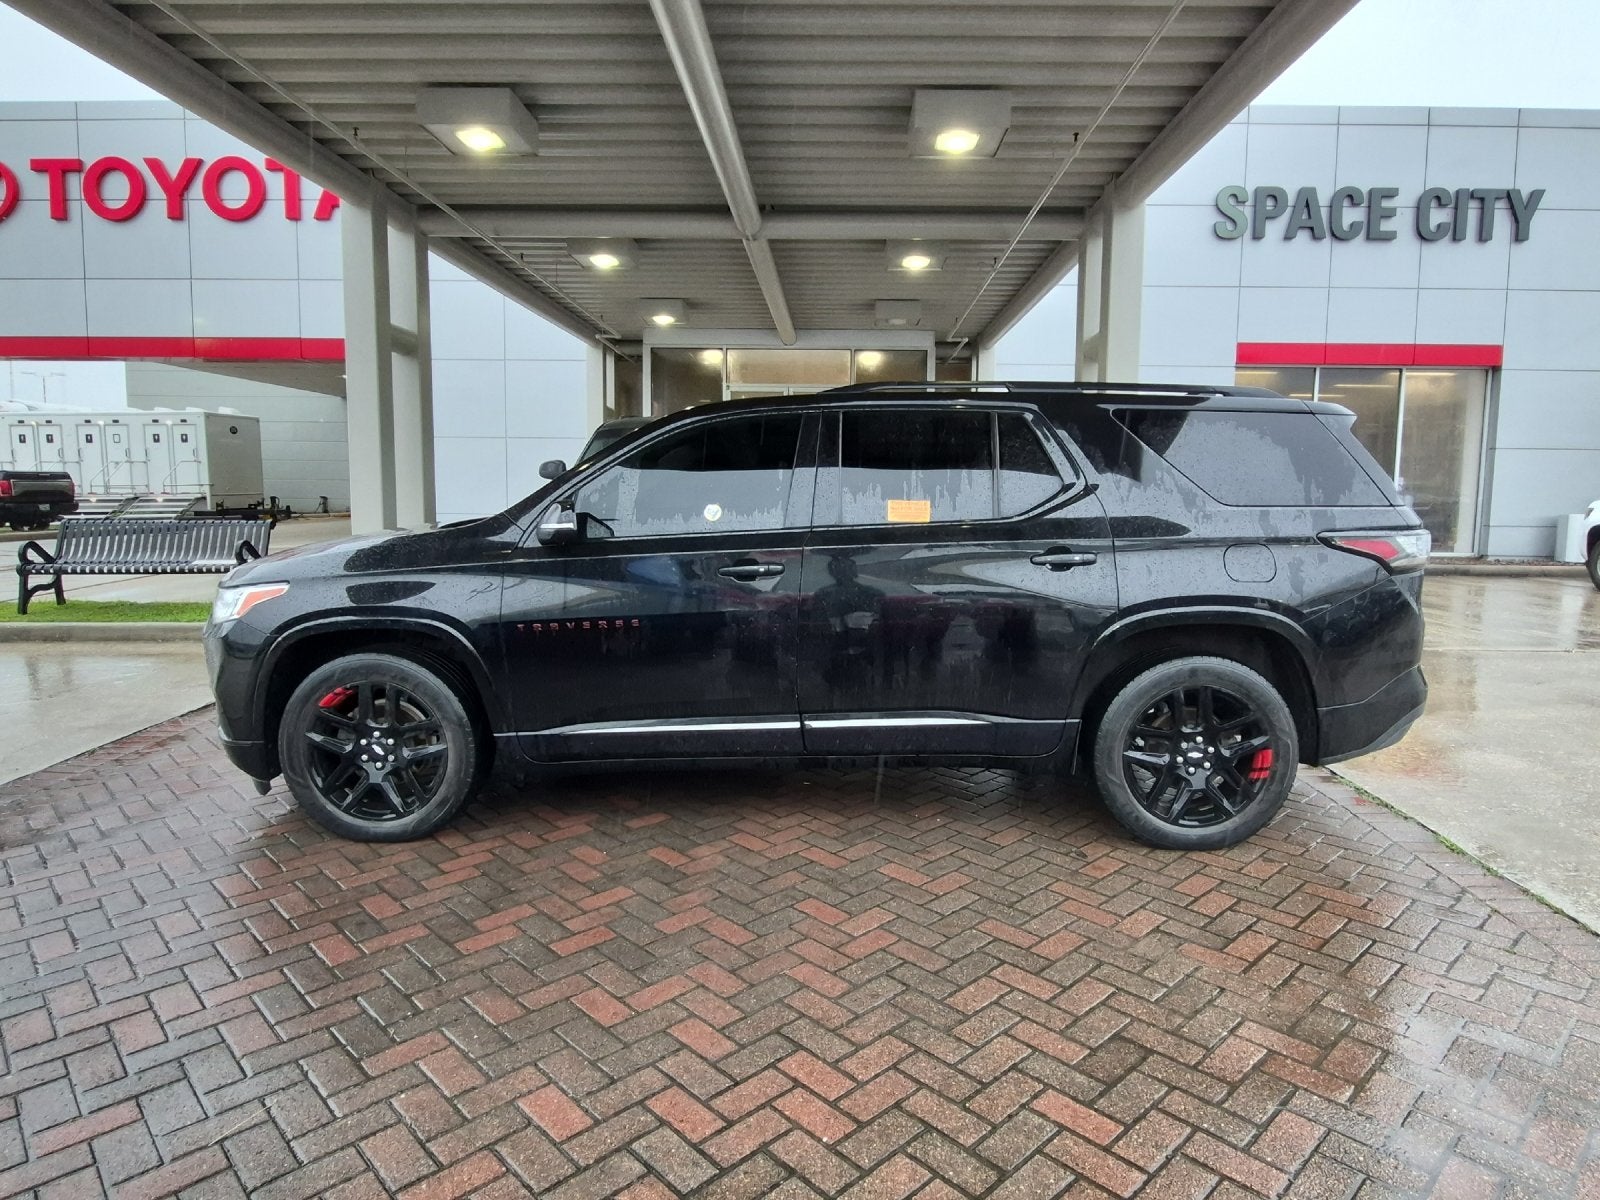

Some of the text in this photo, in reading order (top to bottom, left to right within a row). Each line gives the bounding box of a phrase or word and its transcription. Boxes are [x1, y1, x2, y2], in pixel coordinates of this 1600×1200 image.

[1213, 185, 1546, 243] SPACE CITY
[516, 618, 641, 632] TRAVERSE
